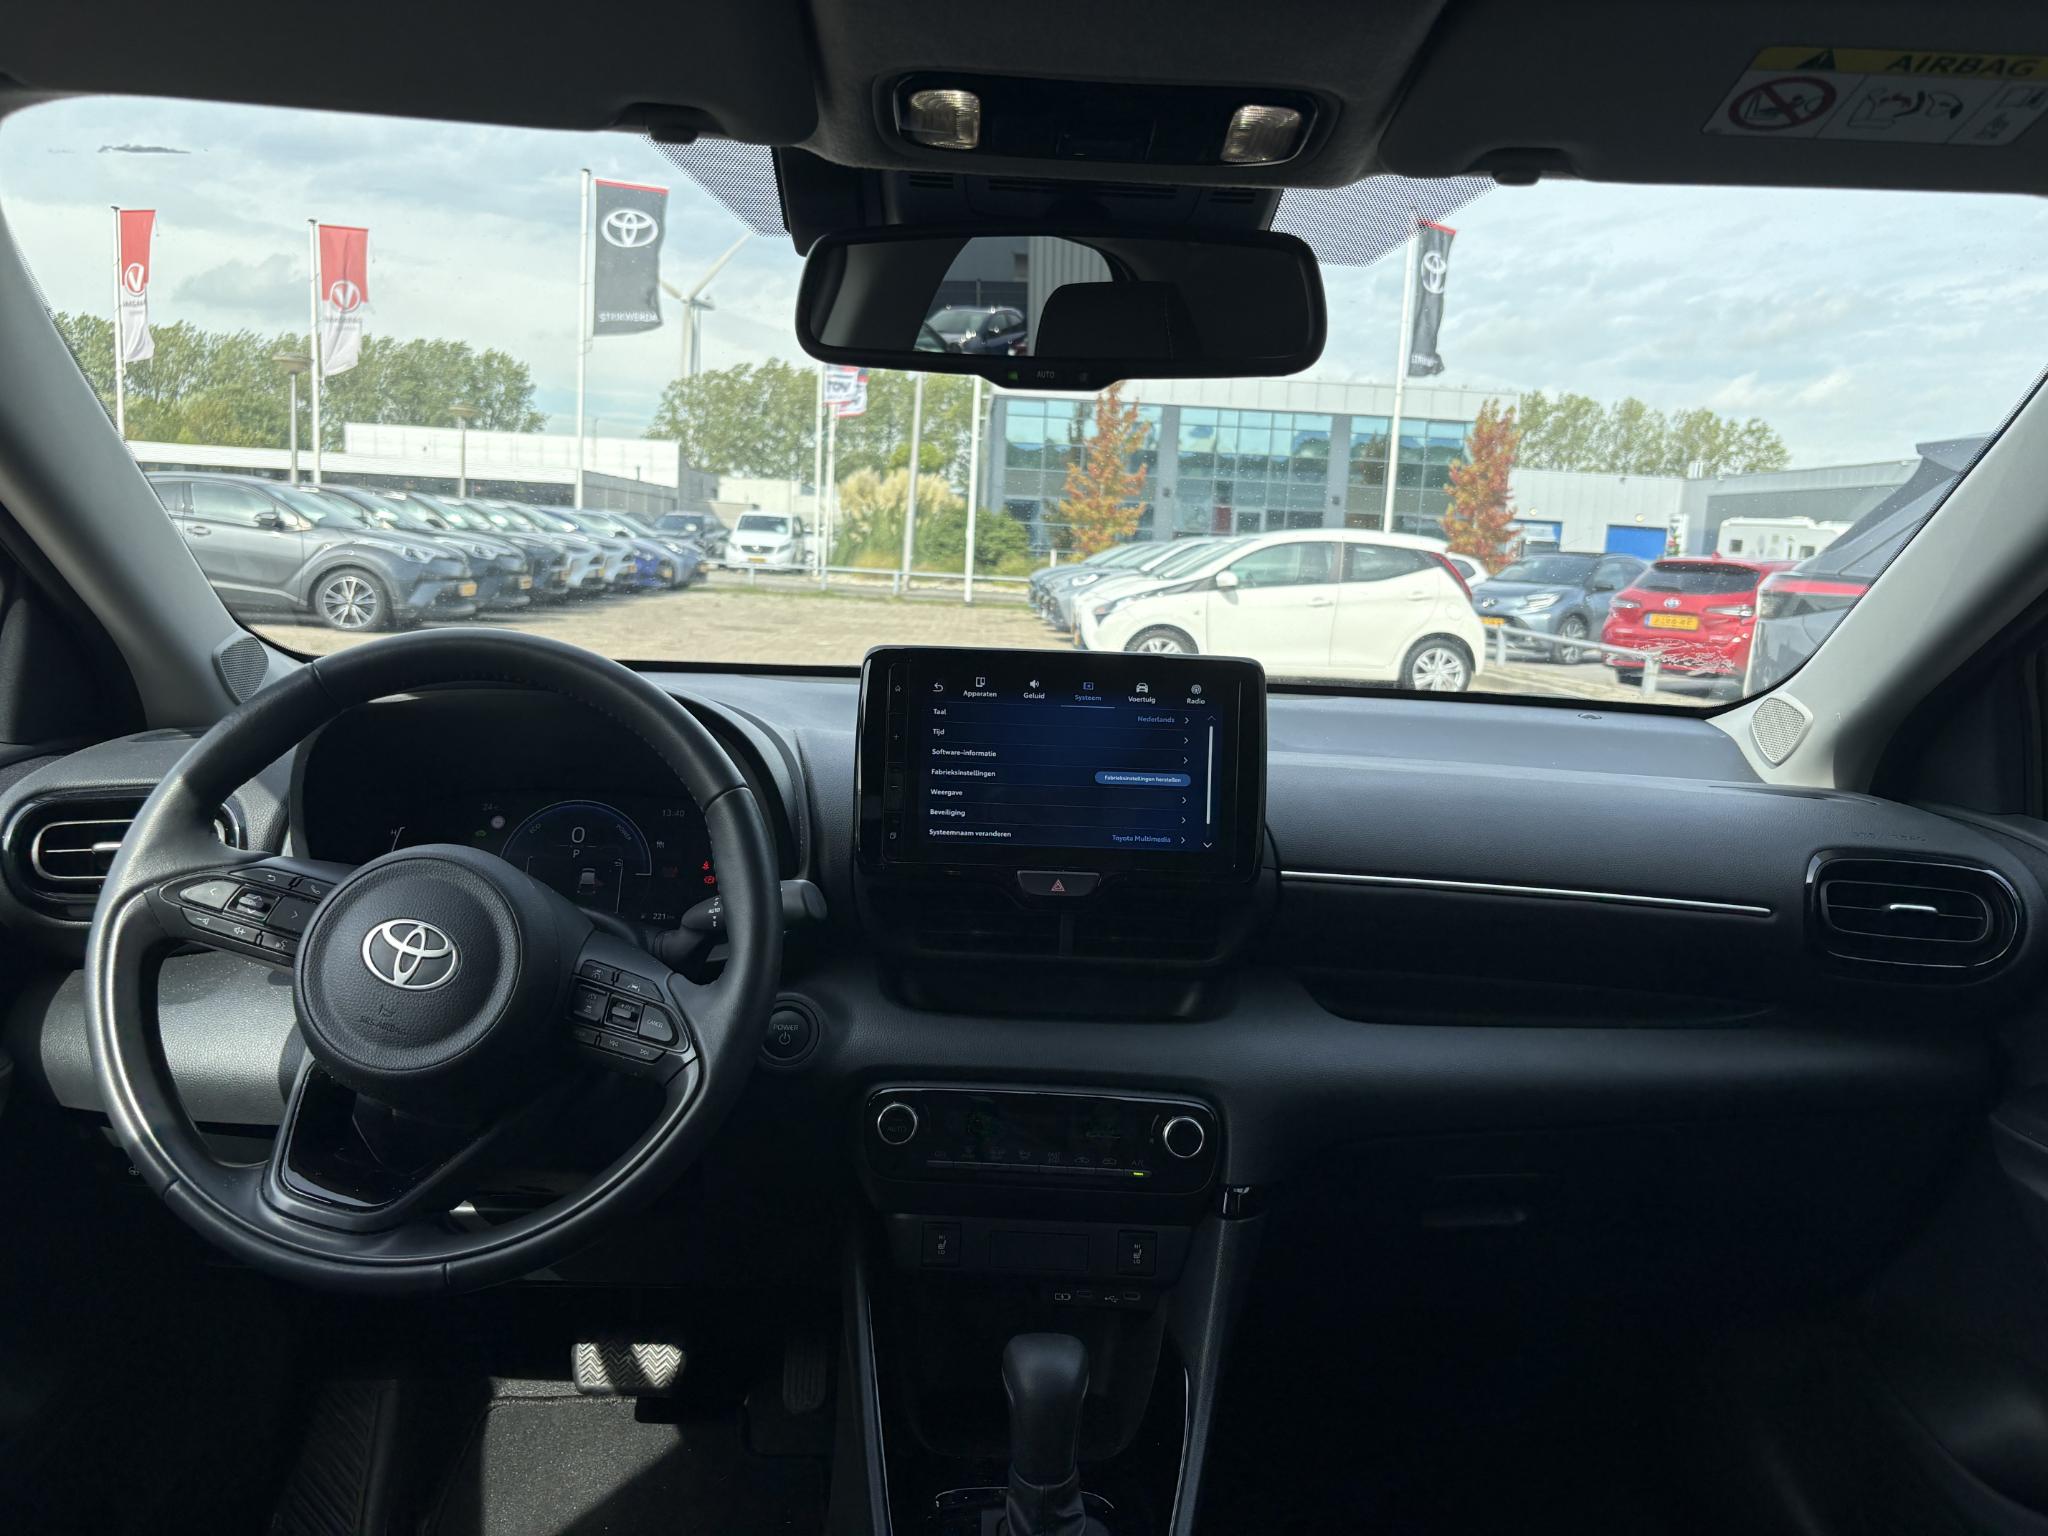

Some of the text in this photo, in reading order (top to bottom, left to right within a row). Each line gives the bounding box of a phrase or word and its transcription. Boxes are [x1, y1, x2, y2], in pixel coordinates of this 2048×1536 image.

[1885, 54, 2040, 77] AIRBAG
[1036, 371, 1055, 379] AUTO
[963, 689, 998, 698] Apparaten
[1023, 692, 1046, 700] Geluid
[1074, 694, 1102, 702] Systeem
[1128, 696, 1156, 705] Voertuig
[933, 708, 947, 716] Taal
[933, 728, 945, 737] Tijd
[931, 748, 997, 757] Software-informatie
[931, 769, 996, 778] Fabrieksinstellingen
[930, 789, 963, 797] Weergave
[929, 809, 966, 817] Beveiliging
[929, 828, 1012, 838] Systeemnaam veranderen
[1112, 834, 1171, 843] Toyota Multimedia
[572, 849, 581, 858] P
[773, 1023, 799, 1031] POWER
